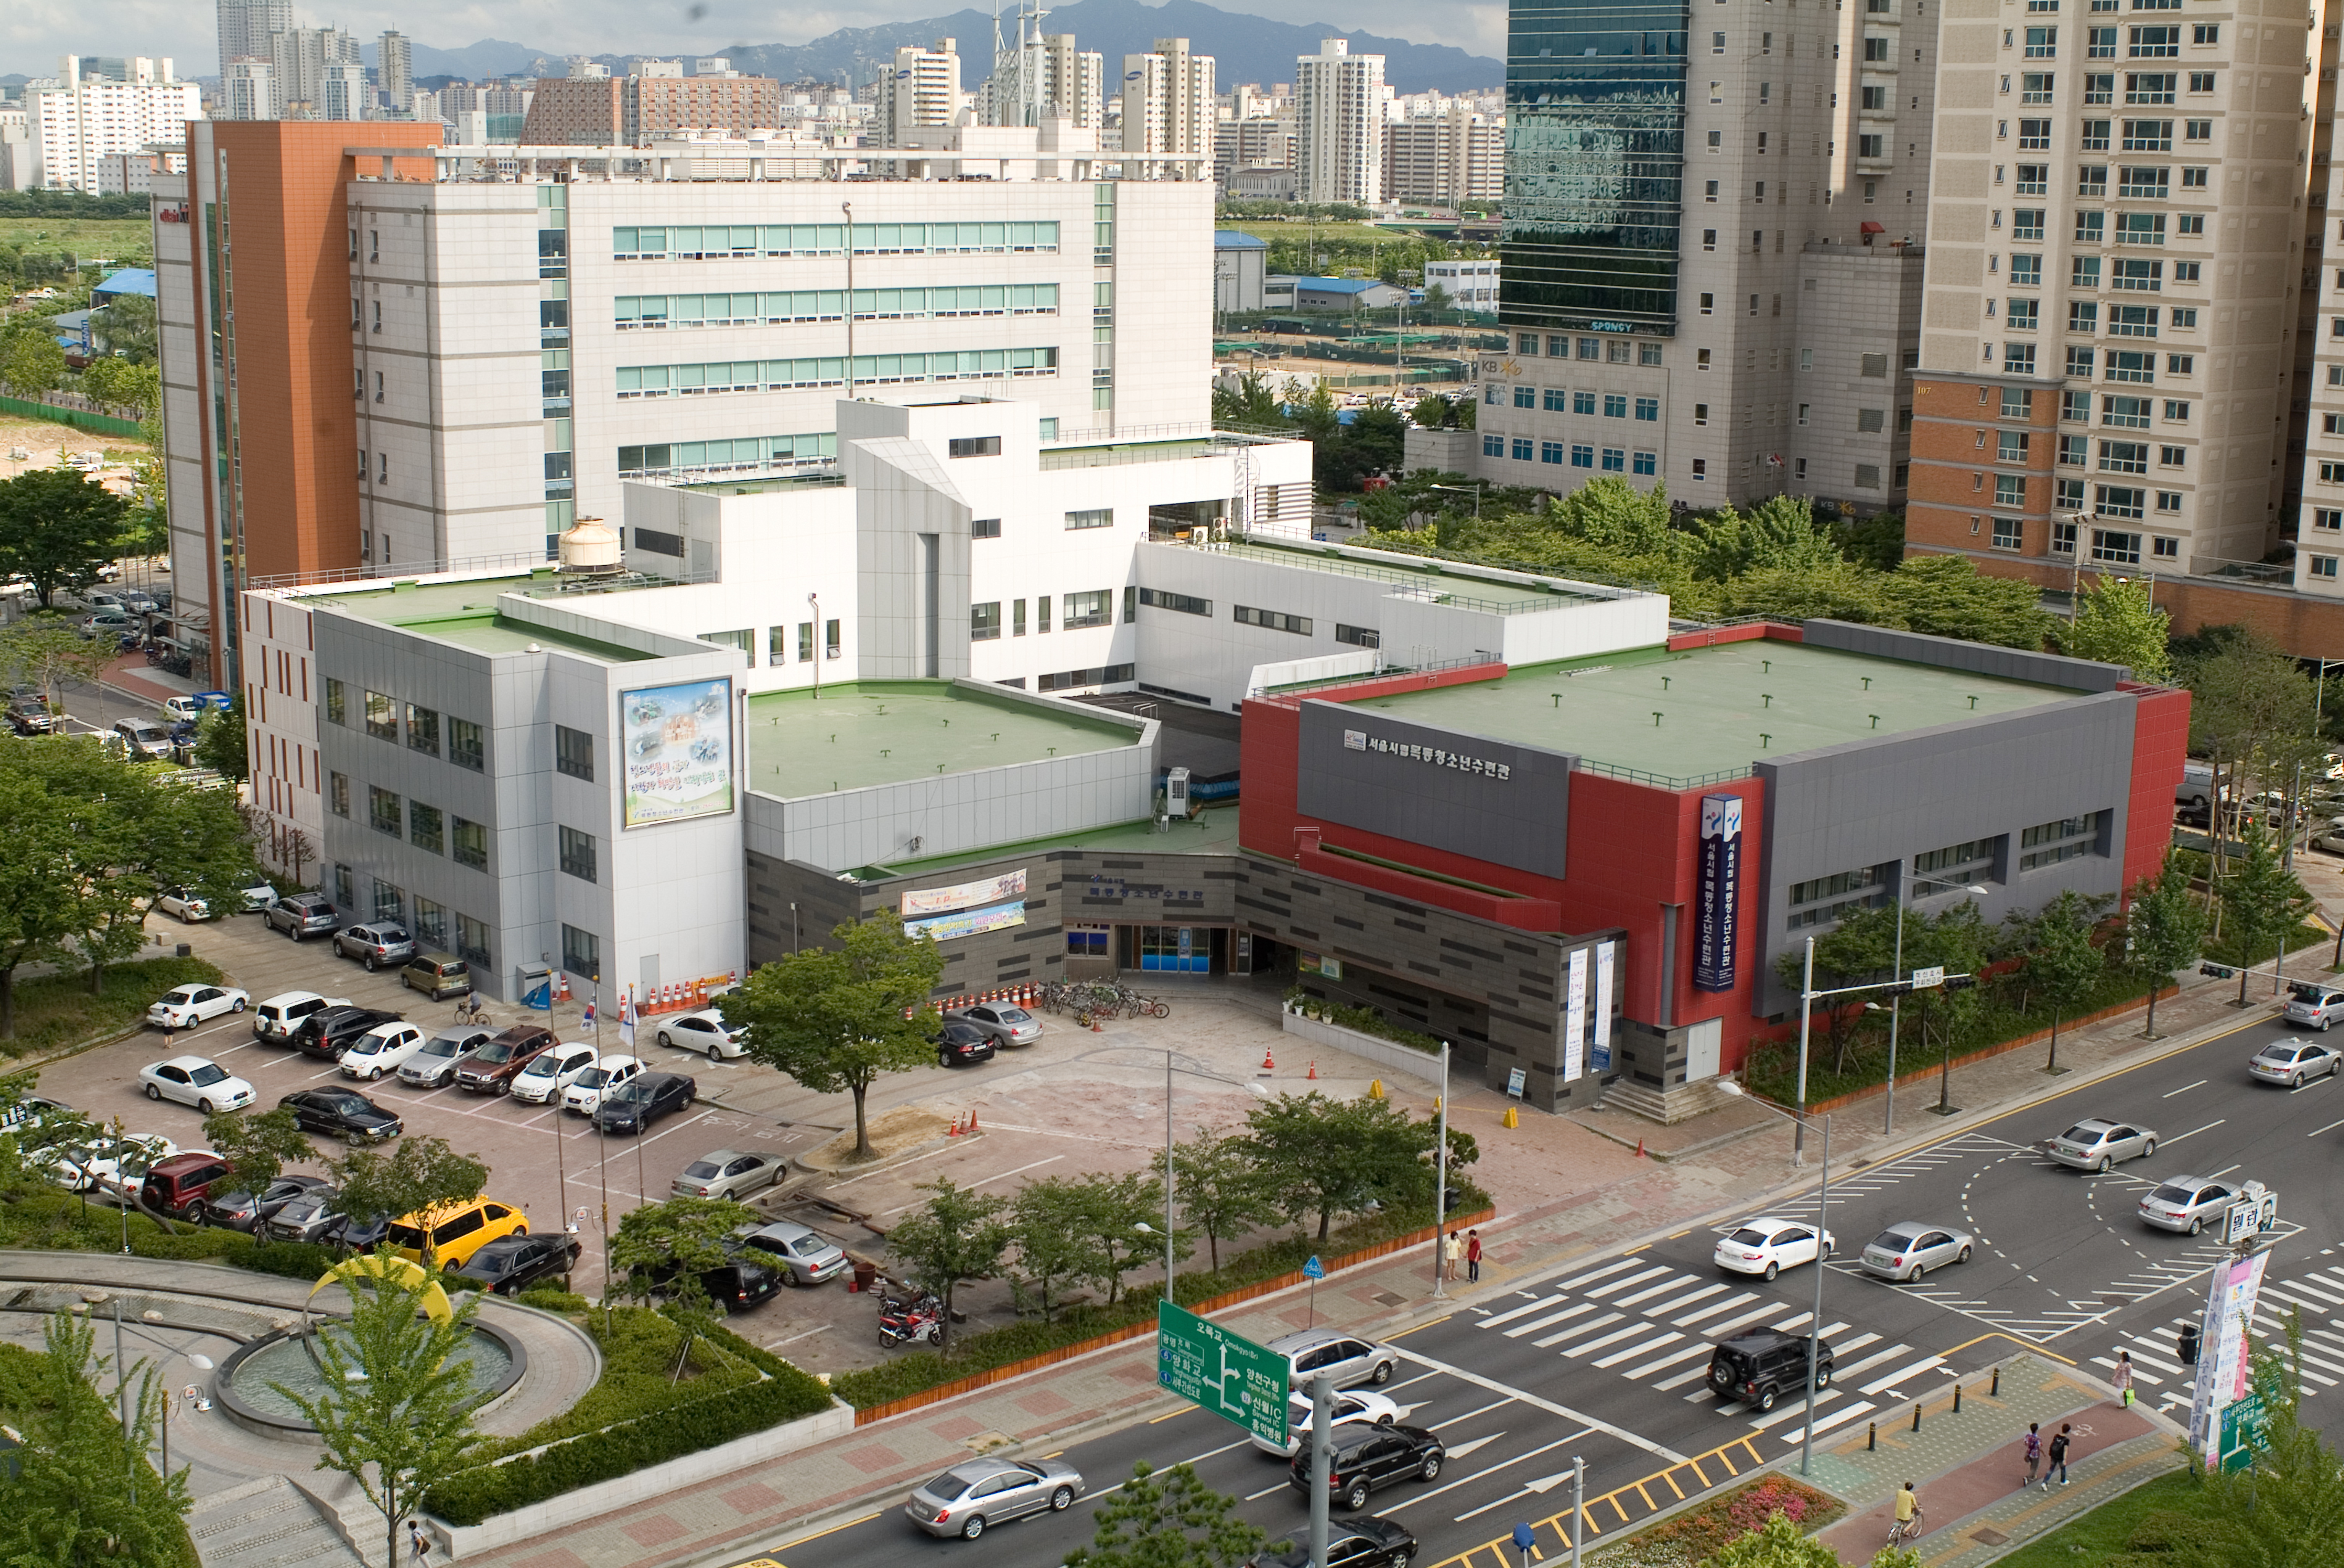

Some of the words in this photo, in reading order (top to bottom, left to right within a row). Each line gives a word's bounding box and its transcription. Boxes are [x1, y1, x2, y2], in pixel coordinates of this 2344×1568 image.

[1481, 360, 1497, 373] KB
[1917, 387, 1931, 395] 107
[1821, 500, 1835, 511] KB
[1707, 843, 1716, 877] 서울시립
[1726, 843, 1735, 878] 서울시립
[1722, 881, 1734, 967] 목동청소년수련관
[1163, 1333, 1176, 1348] 광명
[1196, 1322, 1223, 1343] 오목교
[1172, 1354, 1201, 1378] 양화교
[1172, 1375, 1201, 1400] 서부간선도로
[1246, 1367, 1279, 1393] 양천구청
[1252, 1396, 1282, 1420] 신월IC
[1252, 1408, 1272, 1424] Sinwol
[1272, 1416, 1280, 1428] IC
[1252, 1418, 1281, 1444] 홍익병원
